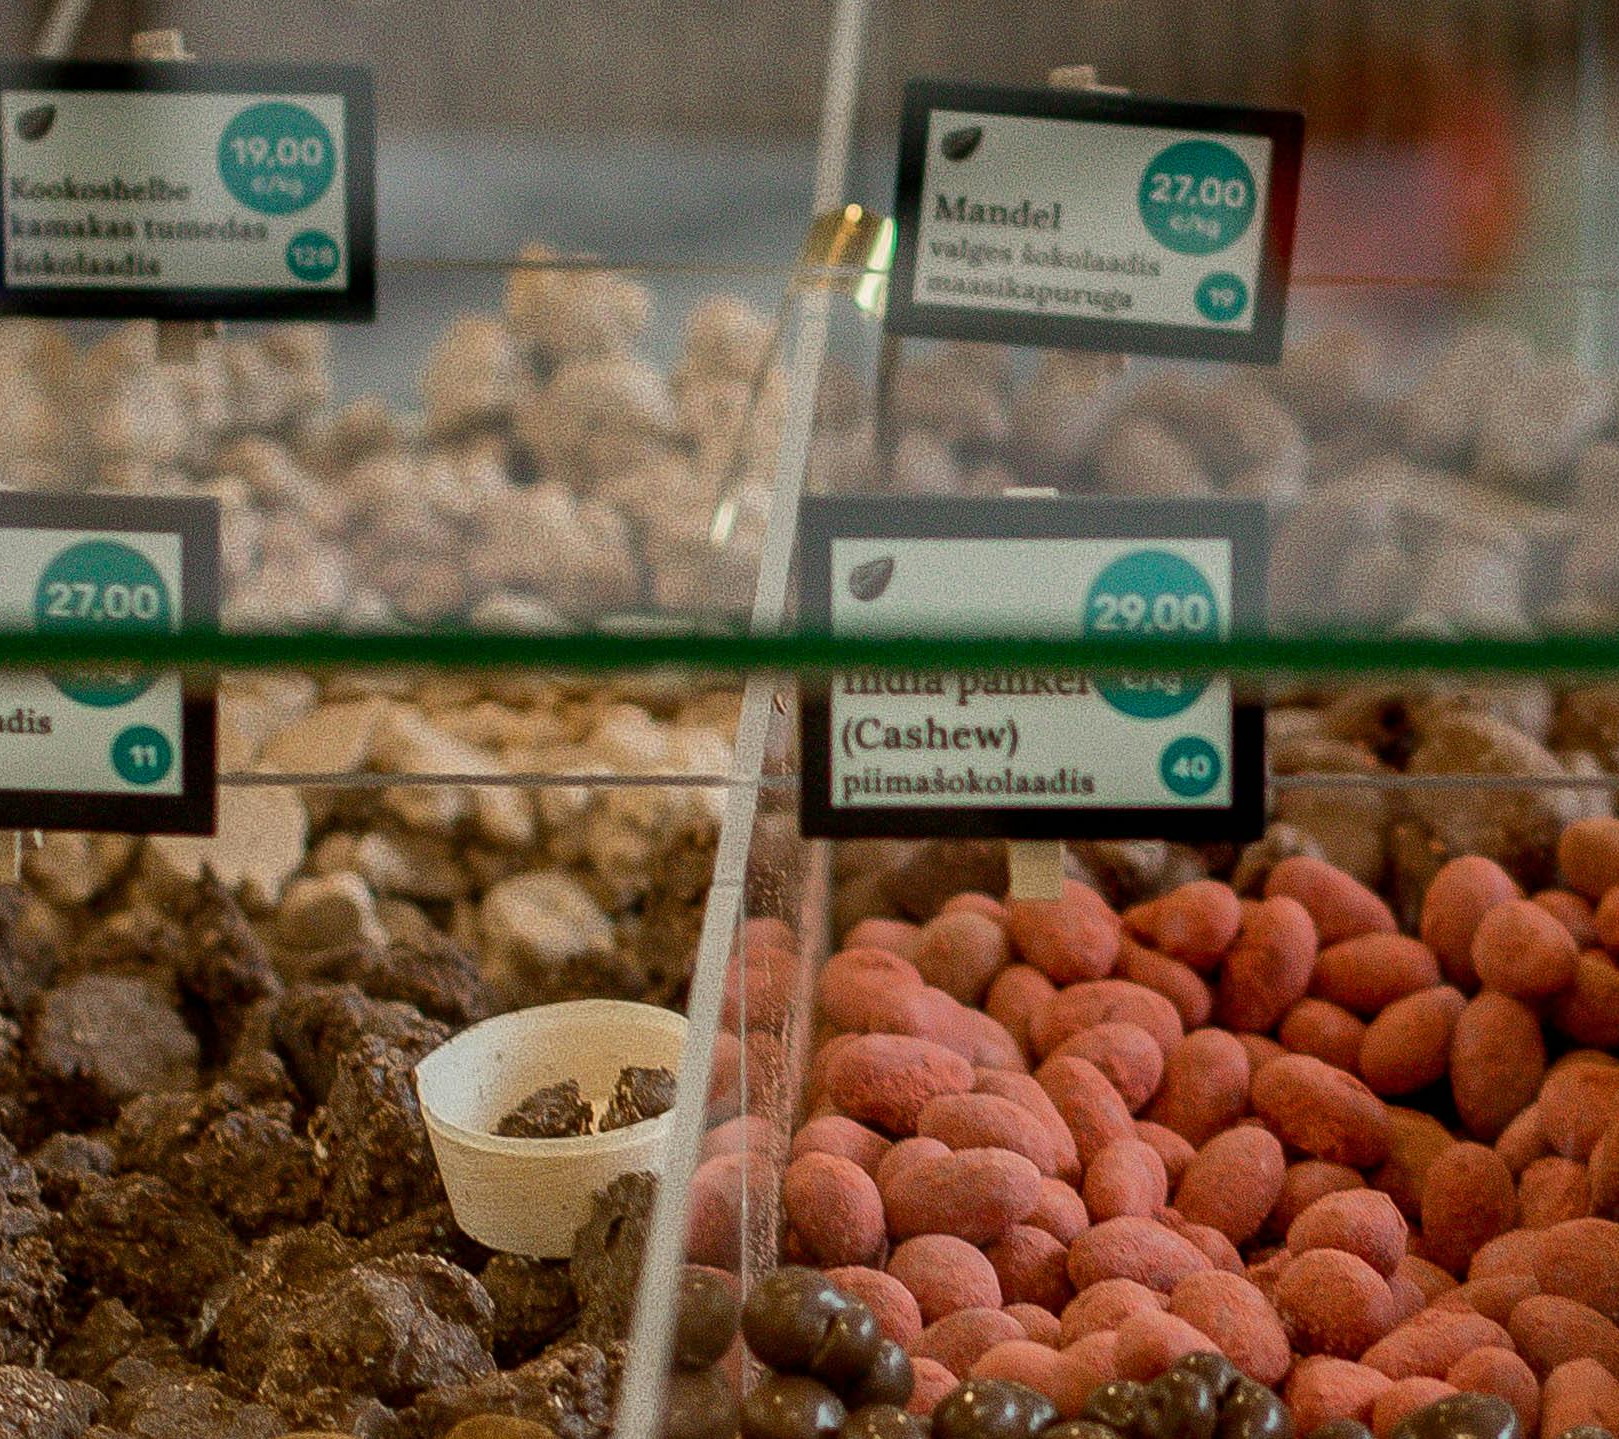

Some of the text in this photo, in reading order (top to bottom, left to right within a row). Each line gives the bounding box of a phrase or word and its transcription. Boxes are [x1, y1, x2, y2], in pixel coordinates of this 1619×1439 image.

[232, 136, 323, 166] 19.00
[1150, 173, 1247, 208] 27.00
[143, 215, 269, 241] tumedas
[936, 193, 1062, 229] Mandel
[11, 249, 162, 276] šokolaadis
[930, 239, 1162, 277] valges šokolaadis
[46, 582, 160, 622] 27.00
[1094, 593, 1212, 633] 29.00
[841, 716, 1022, 759] (Cashew)
[129, 744, 159, 768] 11
[843, 767, 1097, 801] piimašokolaadis
